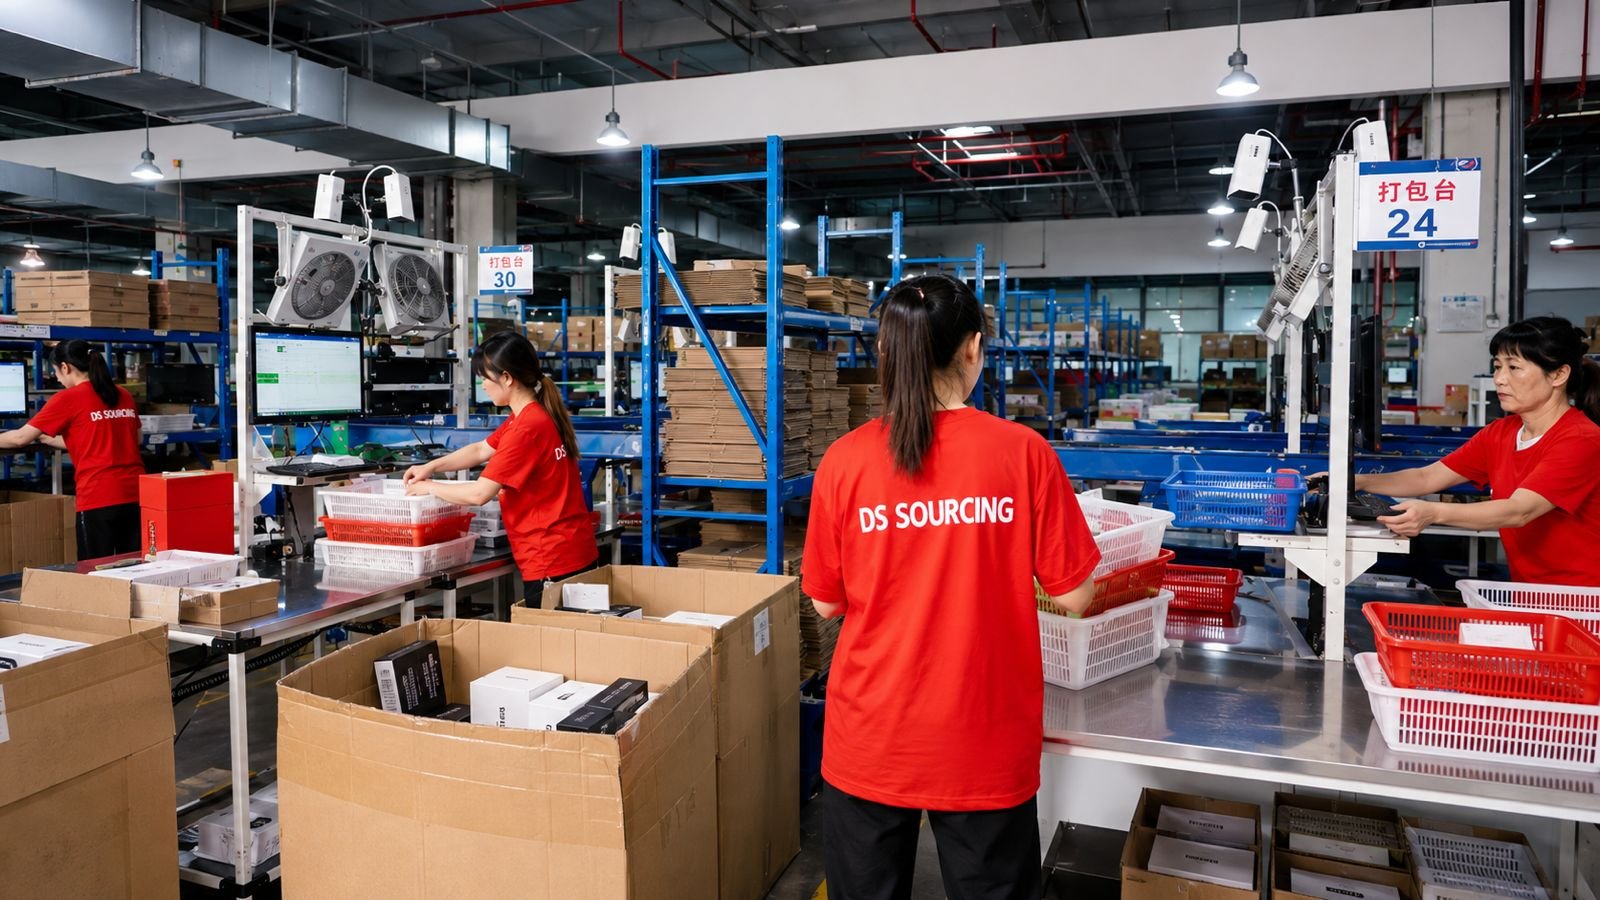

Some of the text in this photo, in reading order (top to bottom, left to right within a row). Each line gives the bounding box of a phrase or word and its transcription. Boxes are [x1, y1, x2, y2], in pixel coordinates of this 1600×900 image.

[1378, 179, 1456, 202] 打包台
[1387, 208, 1438, 238] 24
[489, 256, 523, 268] 打包台
[493, 271, 516, 288] 30
[90, 411, 103, 422] DS
[555, 444, 567, 460] DS
[858, 496, 1014, 534] DS SOURCING
